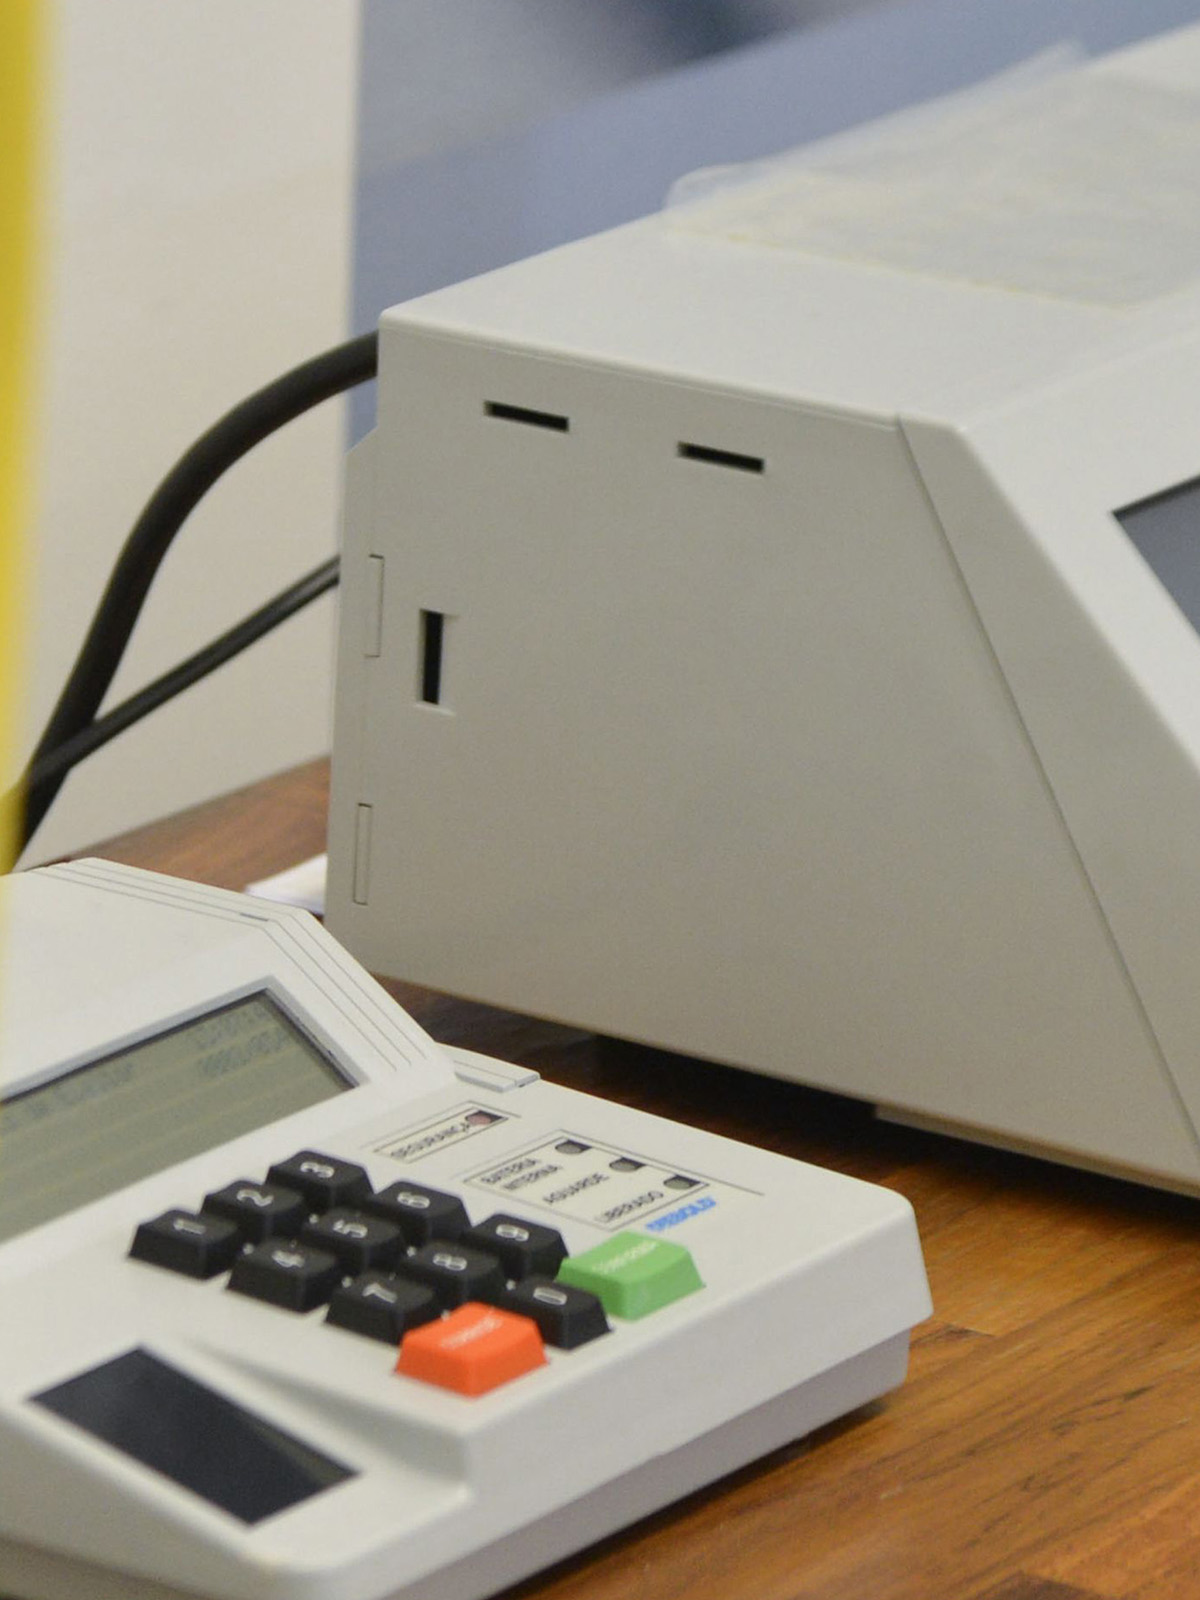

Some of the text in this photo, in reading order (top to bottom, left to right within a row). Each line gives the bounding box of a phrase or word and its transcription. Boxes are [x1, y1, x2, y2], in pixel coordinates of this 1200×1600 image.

[300, 1161, 334, 1178] 3
[543, 1173, 609, 1203] AGUARDE
[237, 1189, 274, 1207] 2
[398, 1192, 430, 1209] 6
[595, 1190, 664, 1223] LIBERADO
[173, 1218, 207, 1234] 1
[333, 1219, 368, 1238] 5
[496, 1224, 529, 1241] 9
[272, 1250, 305, 1268] 4
[433, 1254, 467, 1271] 8
[362, 1282, 398, 1303] 7
[533, 1287, 567, 1305] 0
